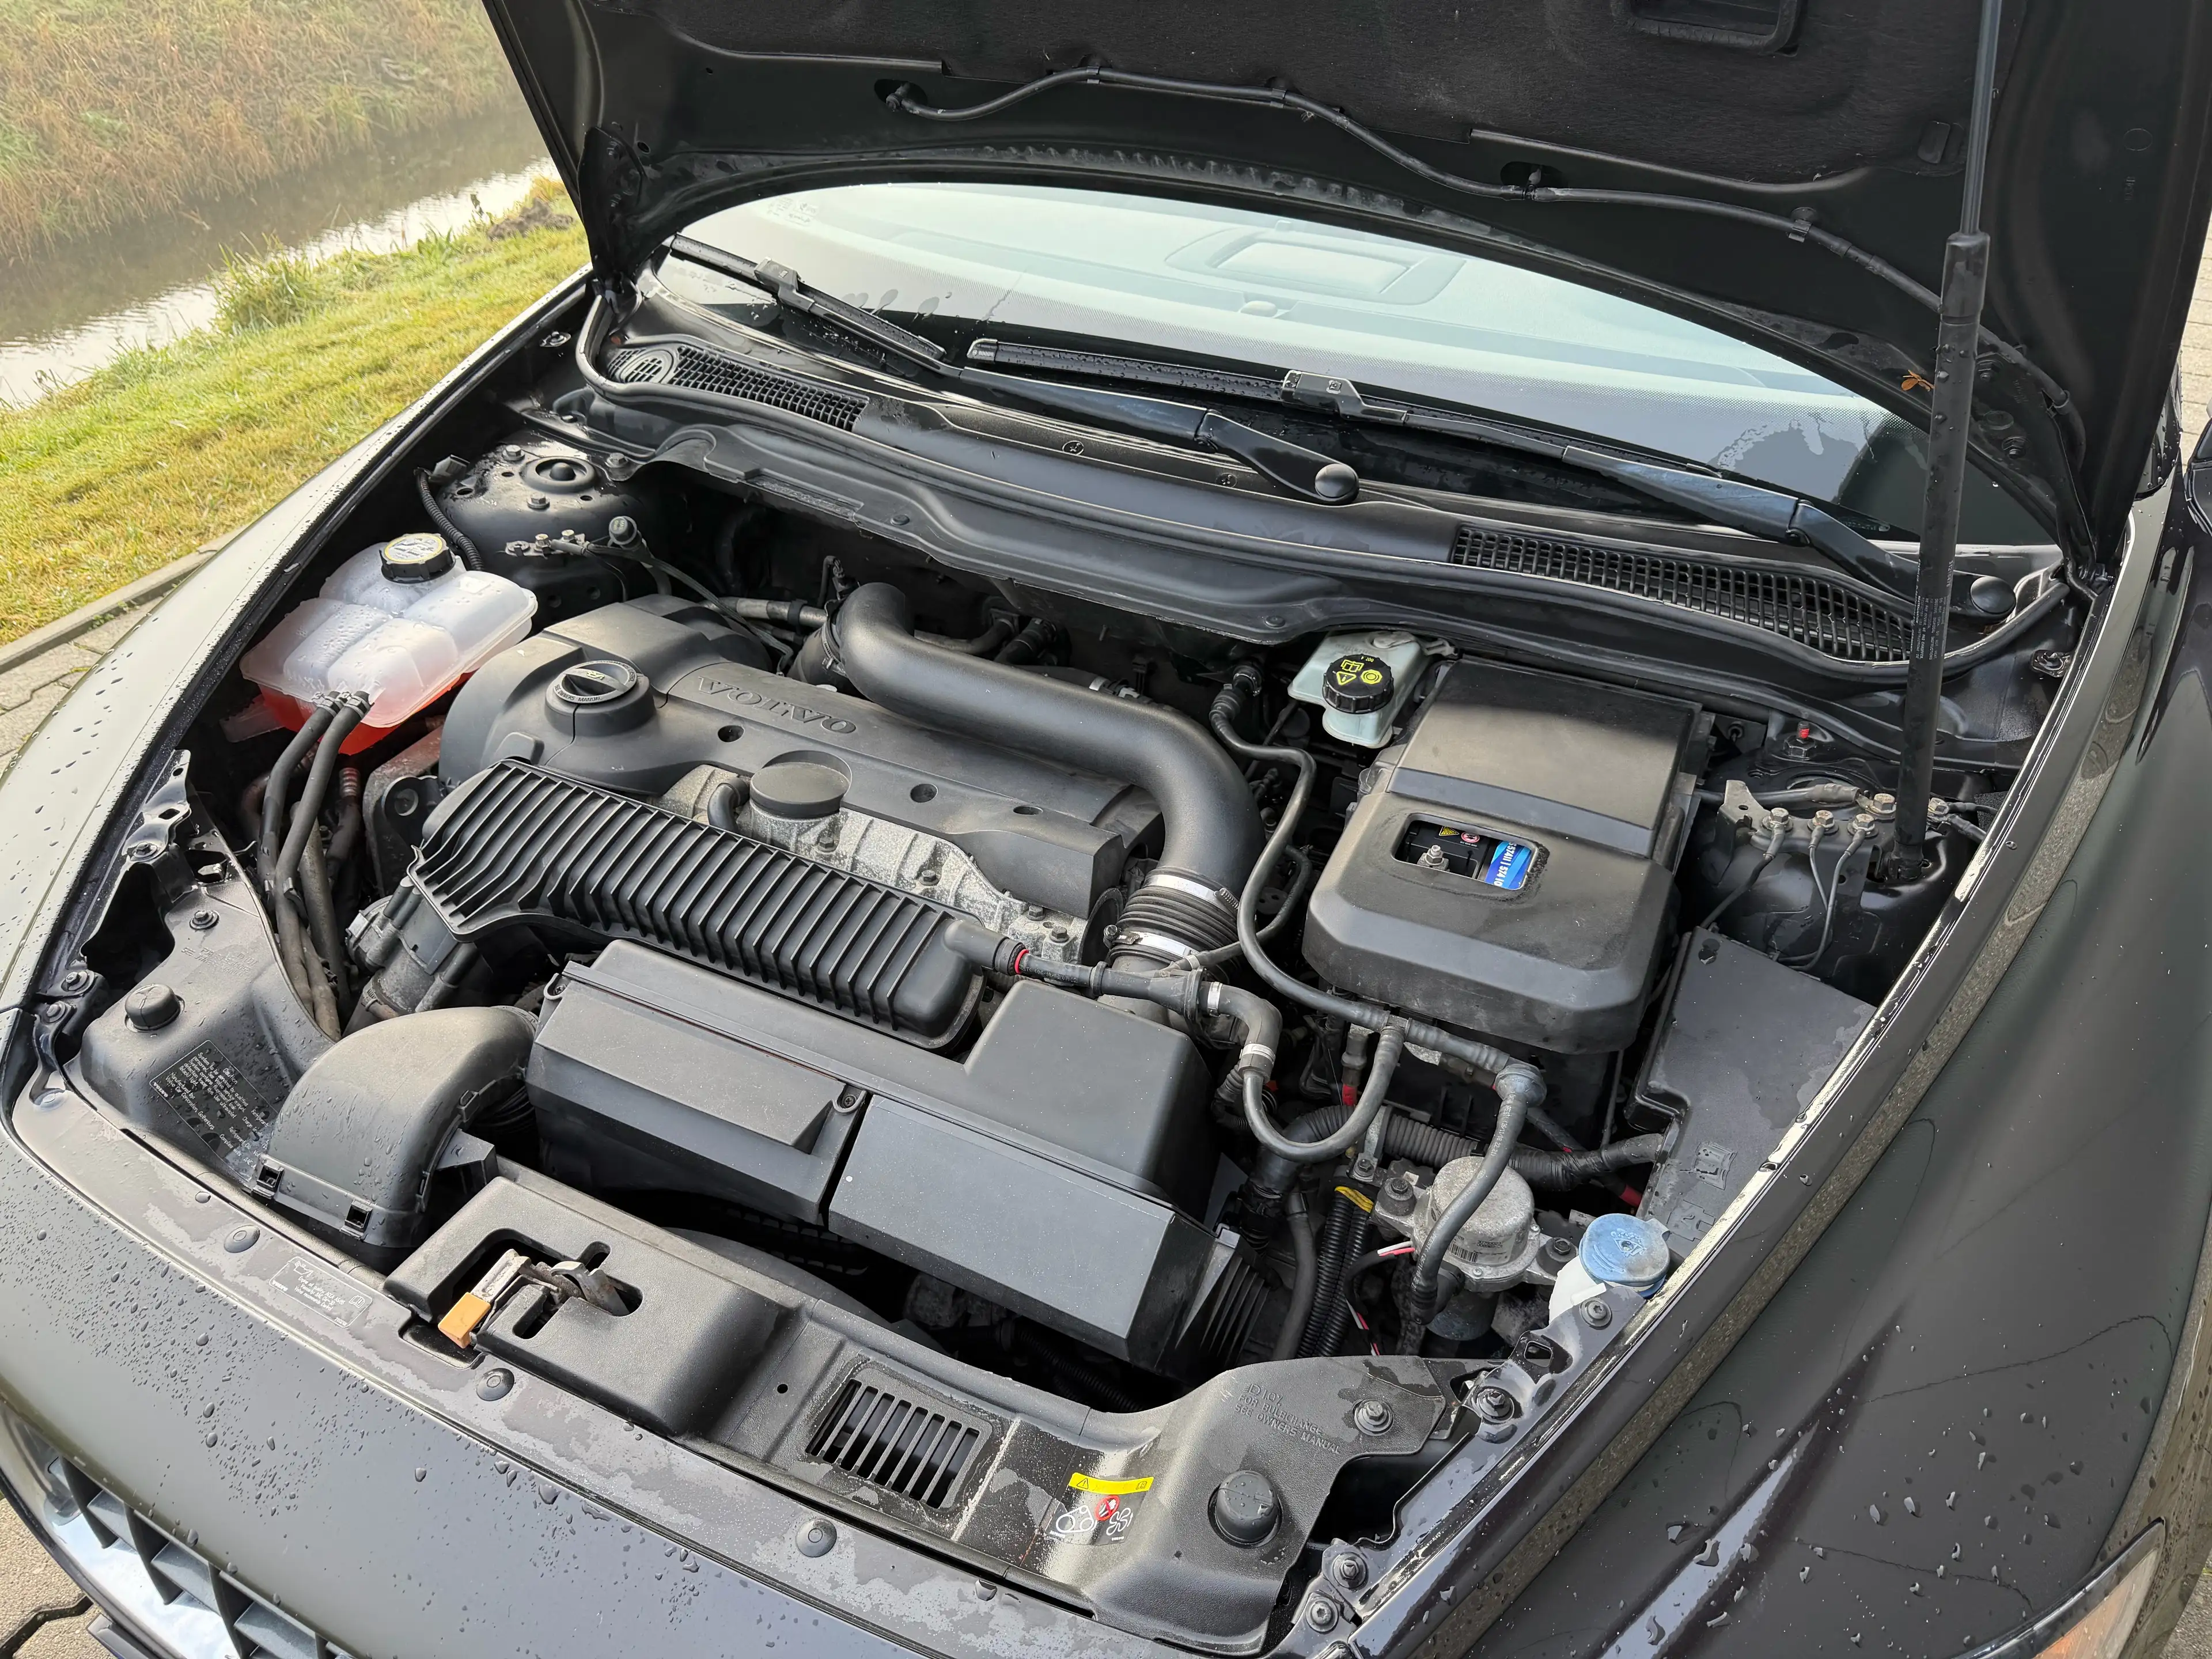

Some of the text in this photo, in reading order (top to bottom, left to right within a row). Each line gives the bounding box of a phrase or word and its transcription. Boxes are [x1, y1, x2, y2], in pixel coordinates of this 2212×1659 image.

[698, 676, 857, 734] VOLVO
[1496, 865, 1508, 878] 574
[181, 946, 195, 956] SEE
[165, 1076, 176, 1087] Volvo
[170, 1073, 190, 1093] Manufactured
[188, 1059, 200, 1072] System
[199, 1071, 213, 1085] contains
[212, 1085, 229, 1103] fluorescent
[192, 1056, 208, 1072] personnel.
[214, 1078, 224, 1088] Volvo
[224, 1089, 234, 1100] service
[198, 1052, 210, 1065] System
[218, 1074, 231, 1087] serviced
[235, 1092, 248, 1106] qualified
[222, 1068, 238, 1084] Caution
[153, 1082, 168, 1097] VOLVO
[198, 1078, 207, 1087] tracer
[219, 1101, 236, 1118] ultraviolet
[241, 1116, 253, 1128] Charge
[228, 1127, 245, 1144] Refrigerant
[219, 1134, 234, 1149] Complies
[244, 1156, 252, 1165] SAE
[298, 1276, 308, 1285] Engine
[294, 1286, 304, 1294] Volvo
[304, 1291, 321, 1304] recommends
[1237, 1394, 1324, 1437] FOR BULBCHANGE
[1234, 1403, 1341, 1455] SEE OWNERS MANUAL
